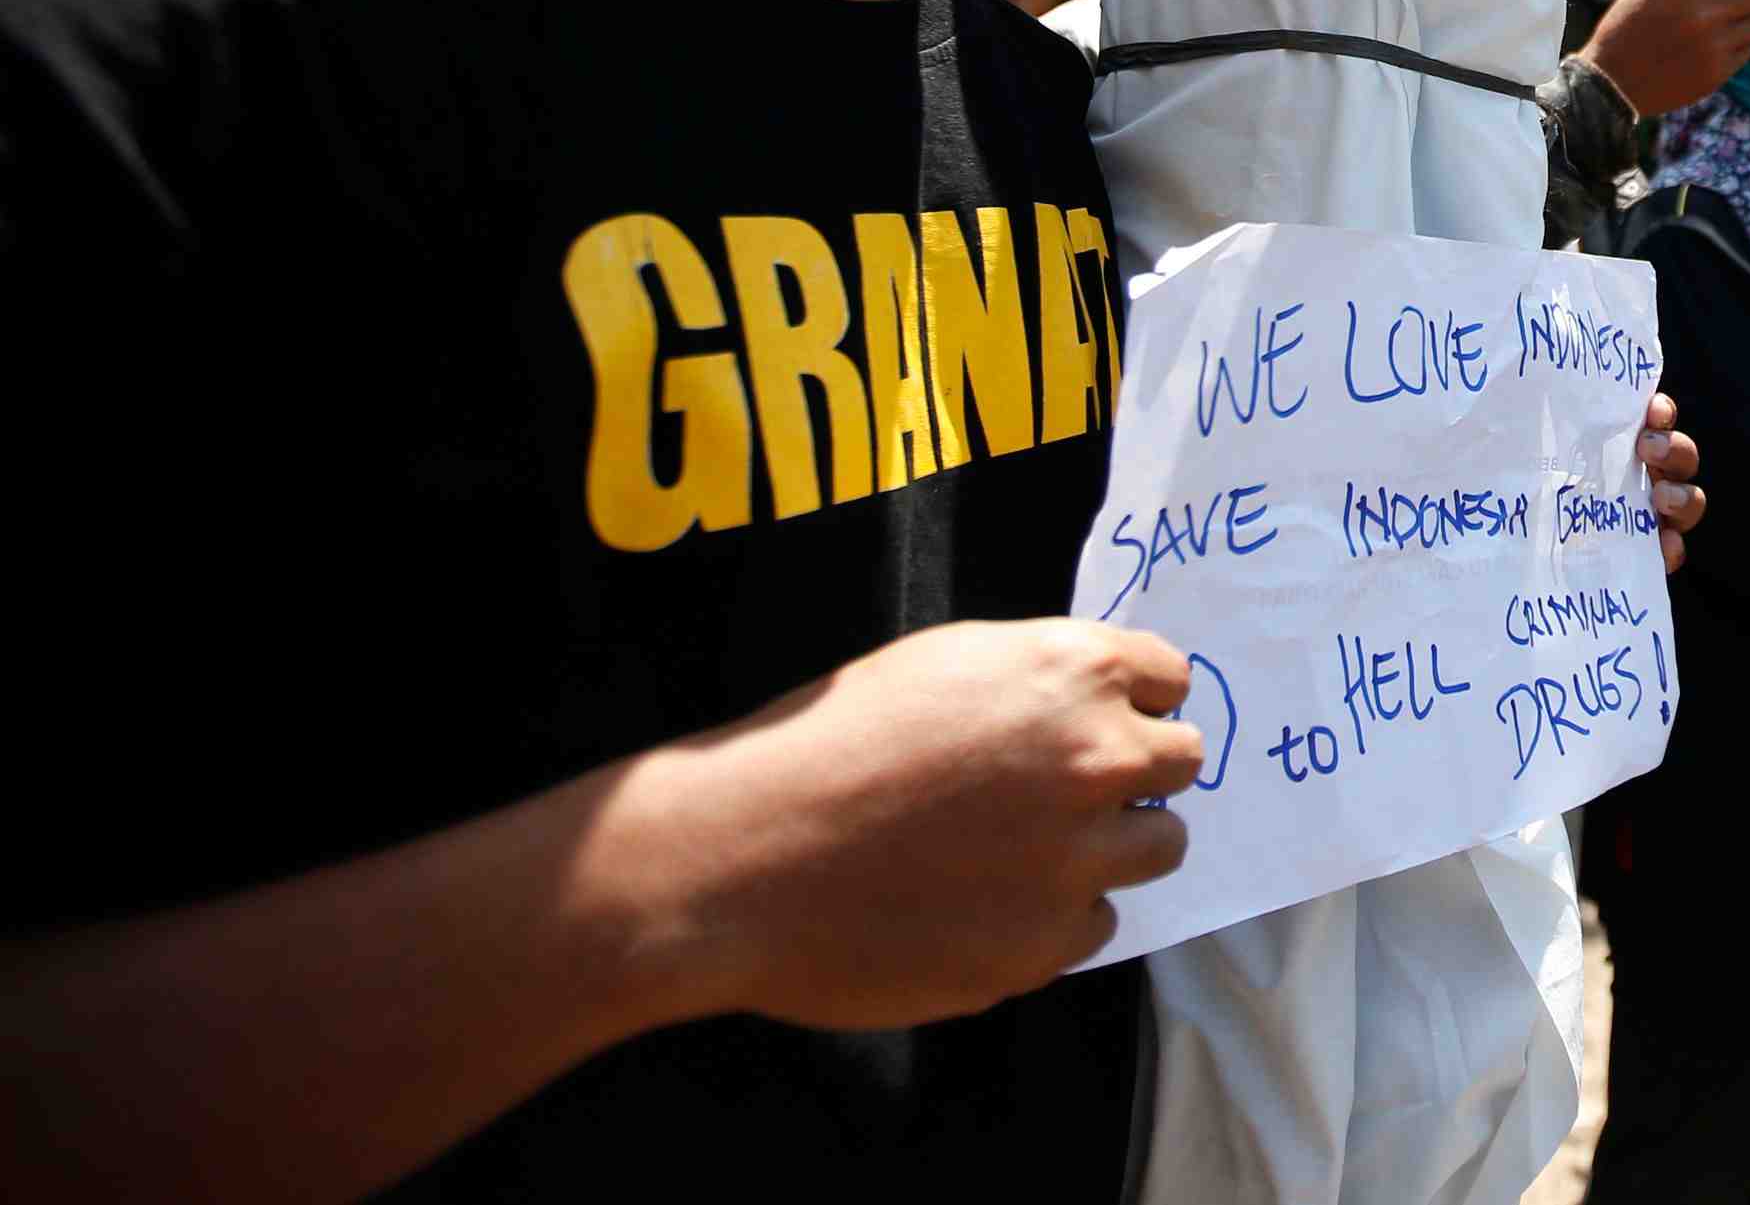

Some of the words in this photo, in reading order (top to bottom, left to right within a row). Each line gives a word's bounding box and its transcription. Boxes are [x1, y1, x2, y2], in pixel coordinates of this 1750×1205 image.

[1197, 301, 1308, 437] WE
[1343, 300, 1488, 404] LOVE
[1515, 291, 1660, 391] INDONESIA
[1099, 482, 1280, 621] SAVE
[1505, 587, 1649, 648] CRIMINAL
[1336, 632, 1472, 755] HELL
